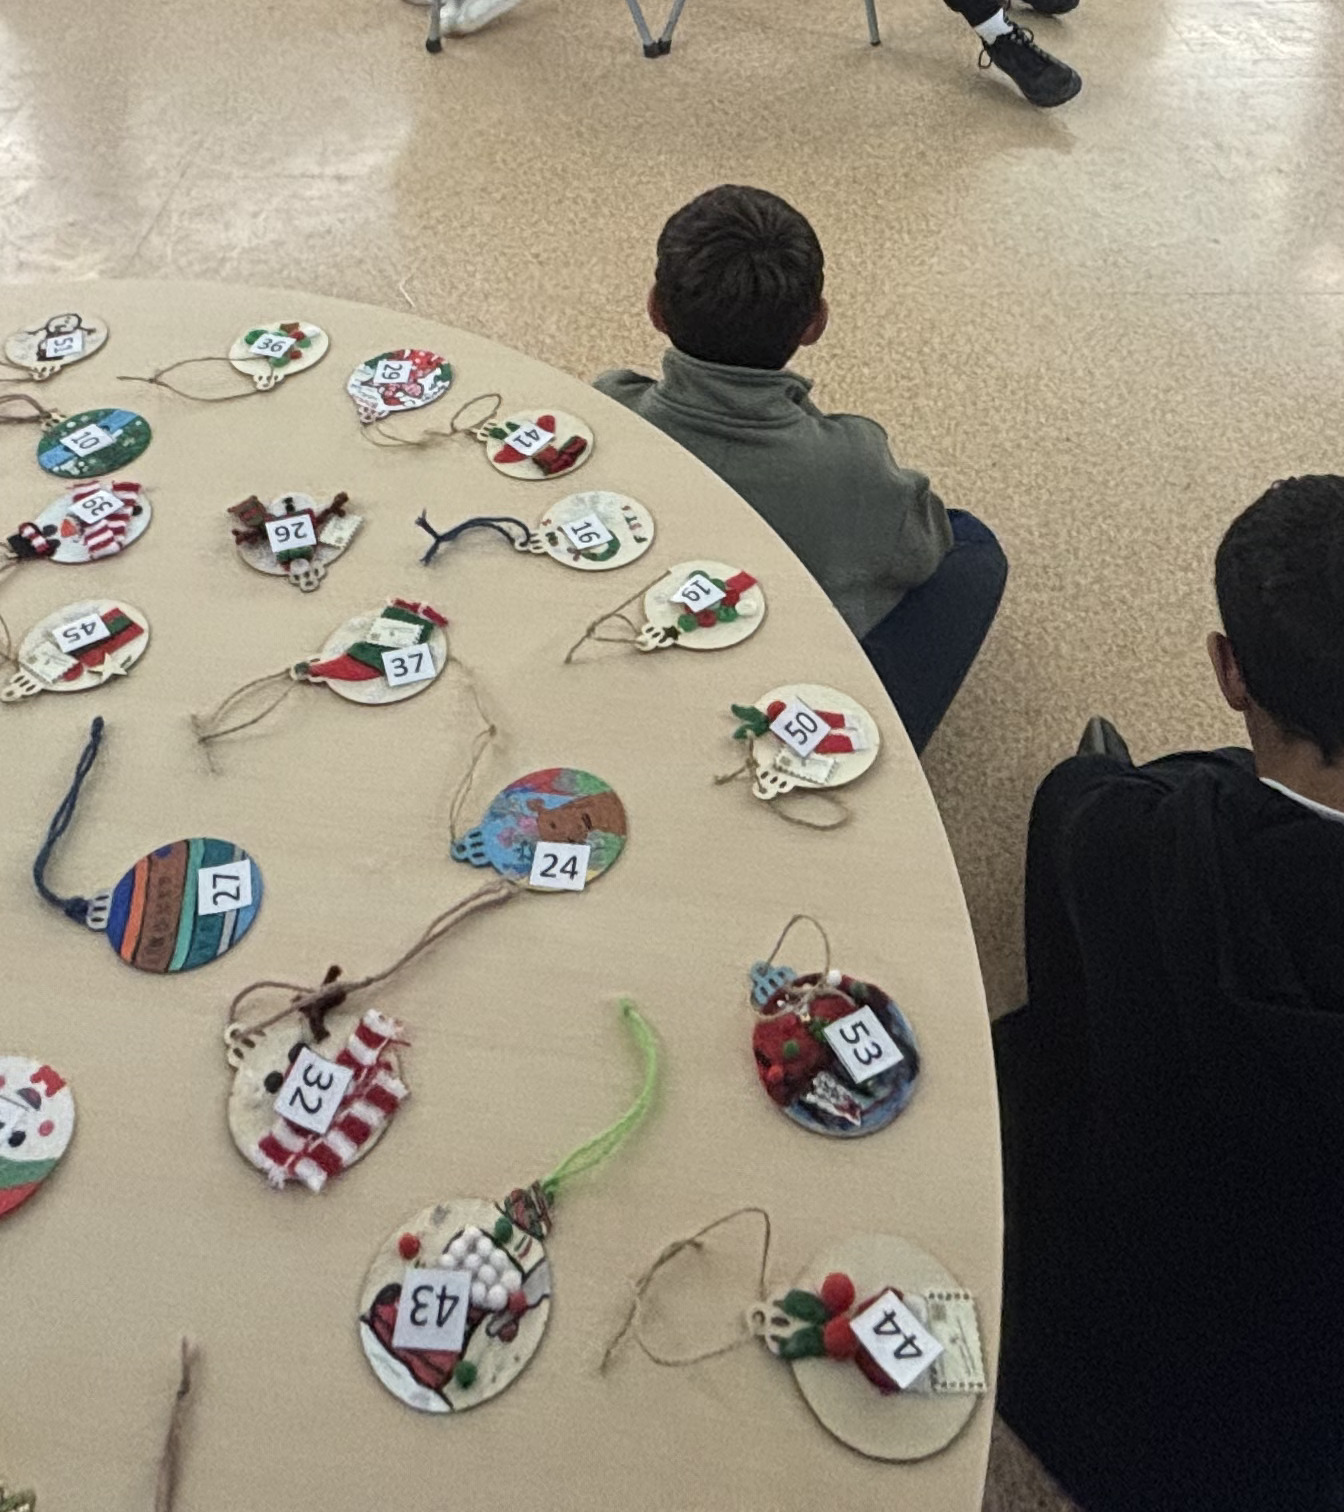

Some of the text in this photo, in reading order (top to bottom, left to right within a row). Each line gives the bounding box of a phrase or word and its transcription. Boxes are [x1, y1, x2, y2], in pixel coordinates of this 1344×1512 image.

[54, 337, 73, 353] 51
[257, 339, 285, 352] 36
[382, 364, 403, 379] 29
[71, 432, 100, 449] 10
[513, 429, 540, 447] 41
[82, 497, 113, 517] 39
[275, 522, 307, 542] 26
[571, 522, 600, 543] 16
[682, 580, 710, 601] 19
[63, 622, 96, 643] 45
[392, 653, 423, 677] 37
[784, 712, 818, 745] 50
[540, 854, 578, 880] 24
[213, 874, 240, 905] 27
[839, 1021, 882, 1065] 53
[289, 1064, 333, 1114] 32
[410, 1289, 459, 1328] 43
[872, 1307, 924, 1360] 44
